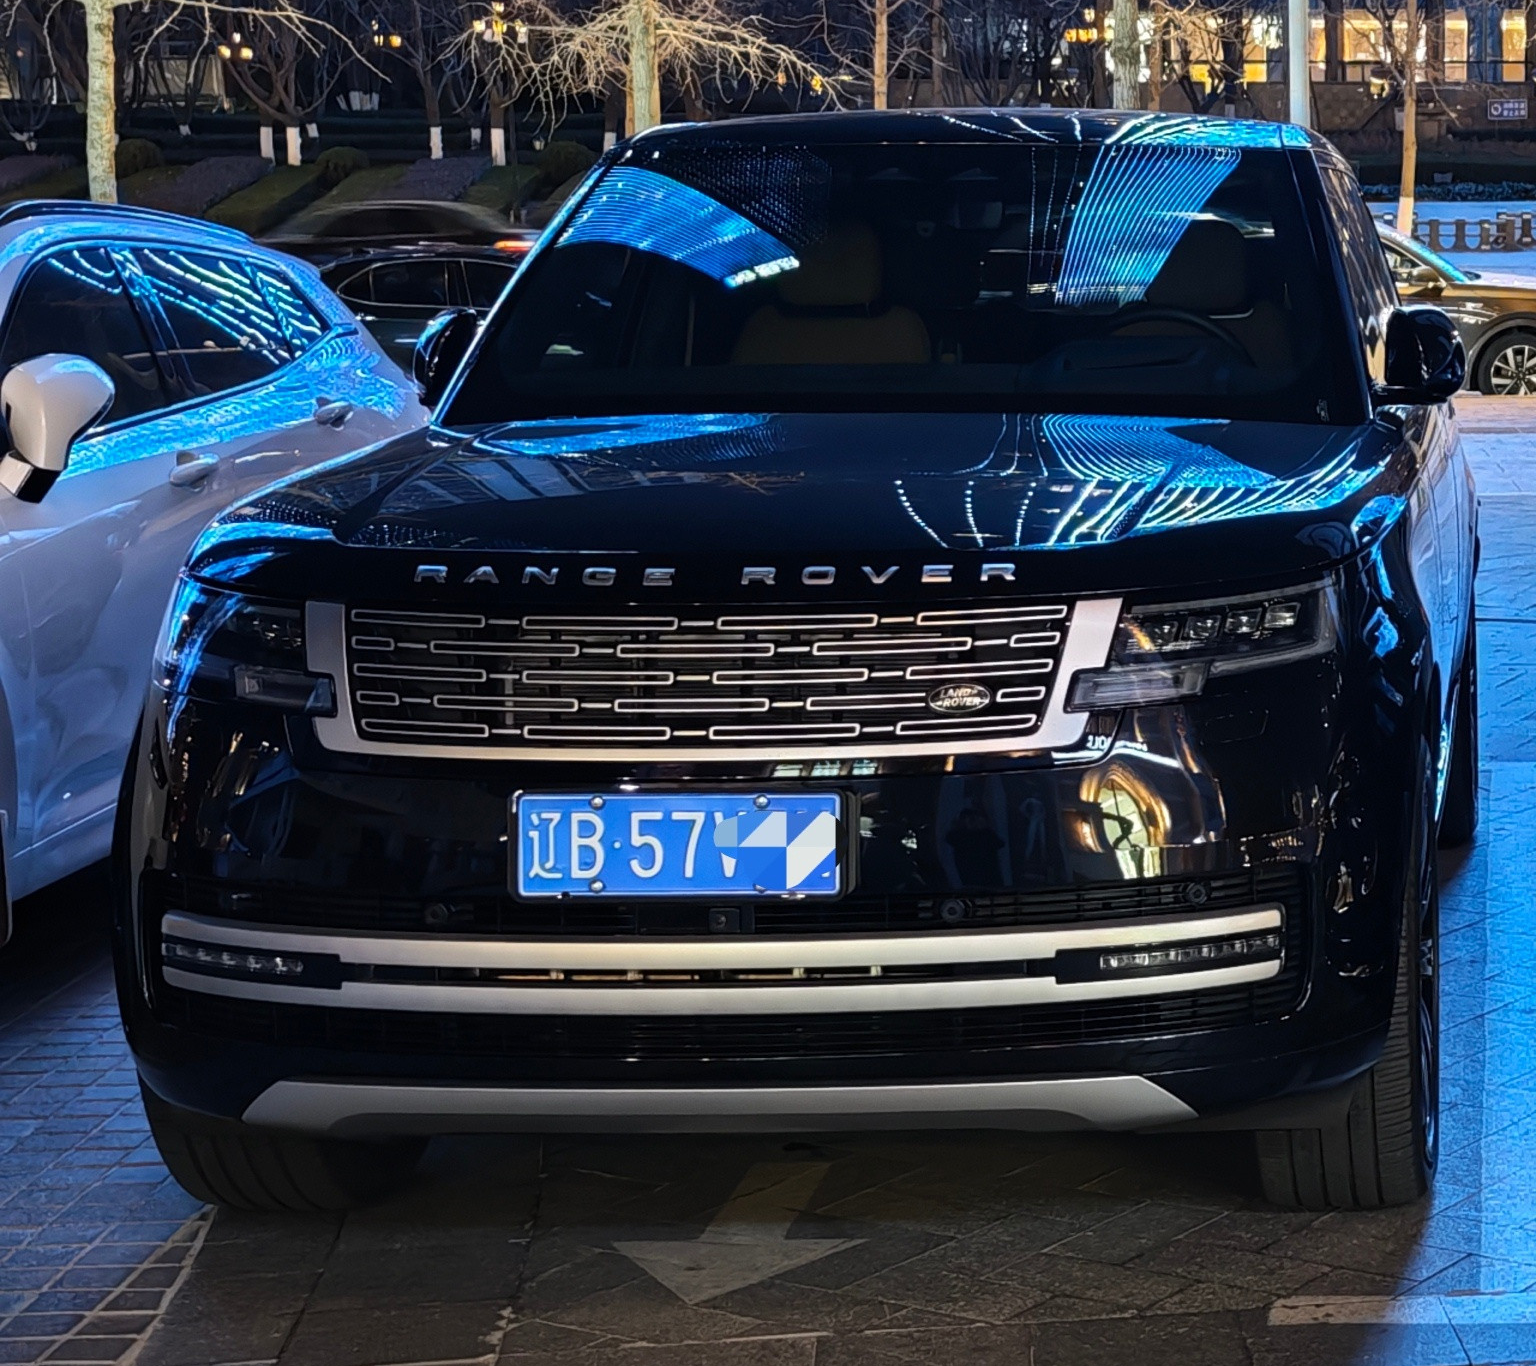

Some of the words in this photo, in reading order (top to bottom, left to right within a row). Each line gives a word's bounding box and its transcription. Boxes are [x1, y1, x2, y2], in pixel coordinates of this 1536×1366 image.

[414, 565, 676, 586] RANGE
[741, 563, 1016, 585] ROVER
[940, 688, 972, 698] LAND
[942, 697, 981, 707] ROVER
